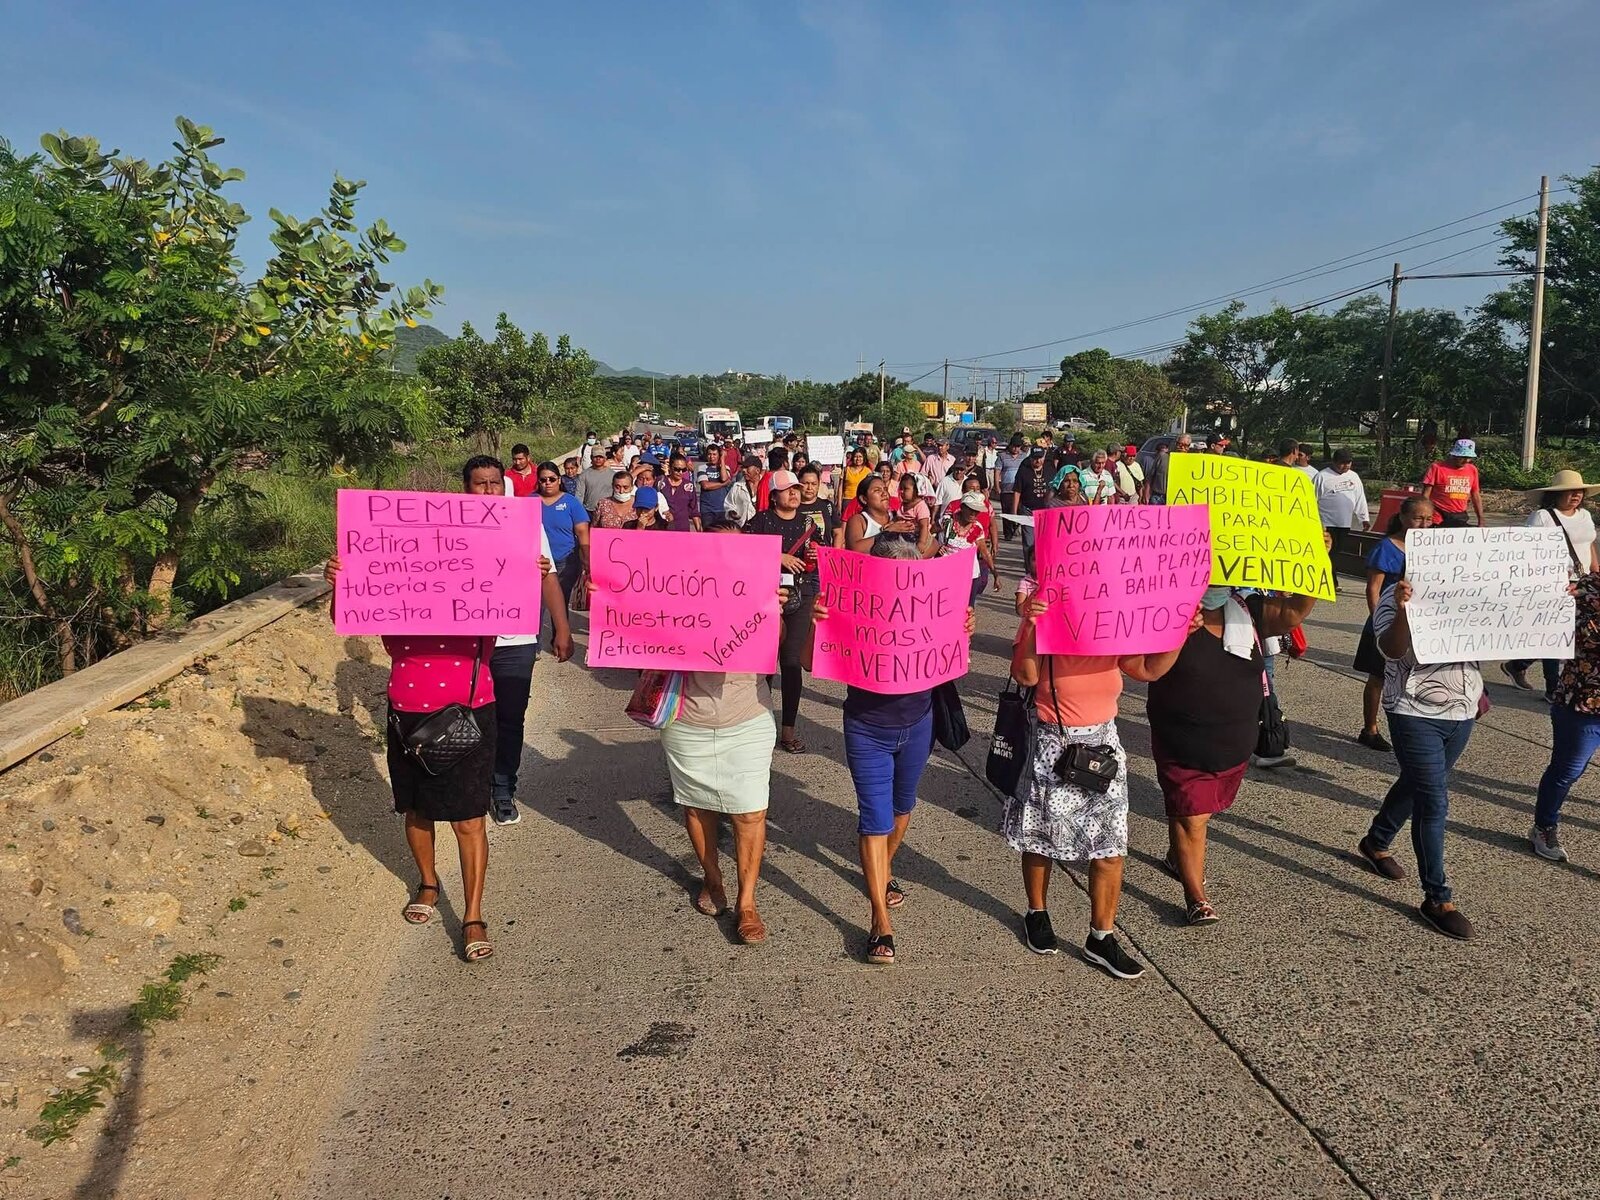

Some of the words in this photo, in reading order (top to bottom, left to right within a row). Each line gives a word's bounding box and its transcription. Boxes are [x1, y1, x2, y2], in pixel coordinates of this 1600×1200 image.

[1191, 460, 1307, 497] JUSTICIA
[368, 495, 508, 525] PEMEX:
[1173, 485, 1319, 523] AMBIENTAL
[1223, 512, 1271, 530] PARA
[347, 528, 419, 554] Retira
[433, 529, 469, 553] tus
[1066, 528, 1210, 555] CONTAMINACIÓN
[1463, 529, 1474, 543] la
[1482, 527, 1542, 543] Ventosa
[1547, 531, 1564, 541] es
[368, 556, 474, 575] emisores
[496, 558, 506, 576] y
[609, 537, 719, 598] Solución
[732, 580, 746, 596] a
[1044, 560, 1100, 582] HACIA
[1120, 556, 1142, 575] LA
[1158, 549, 1211, 572] PLAYA
[1488, 548, 1525, 563] Zona
[461, 577, 493, 593] de
[895, 566, 925, 591] Un
[1047, 586, 1070, 605] DE
[1083, 582, 1109, 600] LA
[1126, 572, 1178, 595] BAHIA
[1190, 571, 1210, 587] LA
[1218, 555, 1331, 597] VENTOSA
[1452, 566, 1499, 583] Pesca
[344, 600, 432, 624] nuestra
[825, 582, 953, 622] DERRAME
[1458, 597, 1508, 613] estas
[606, 605, 711, 628] nuestras
[598, 630, 686, 659] Peticiones
[703, 611, 767, 666] Ventosa
[1418, 630, 1576, 658] CONTAMINACION
[821, 641, 835, 653] en
[840, 642, 852, 657] la
[860, 640, 963, 683] VENTOSA
